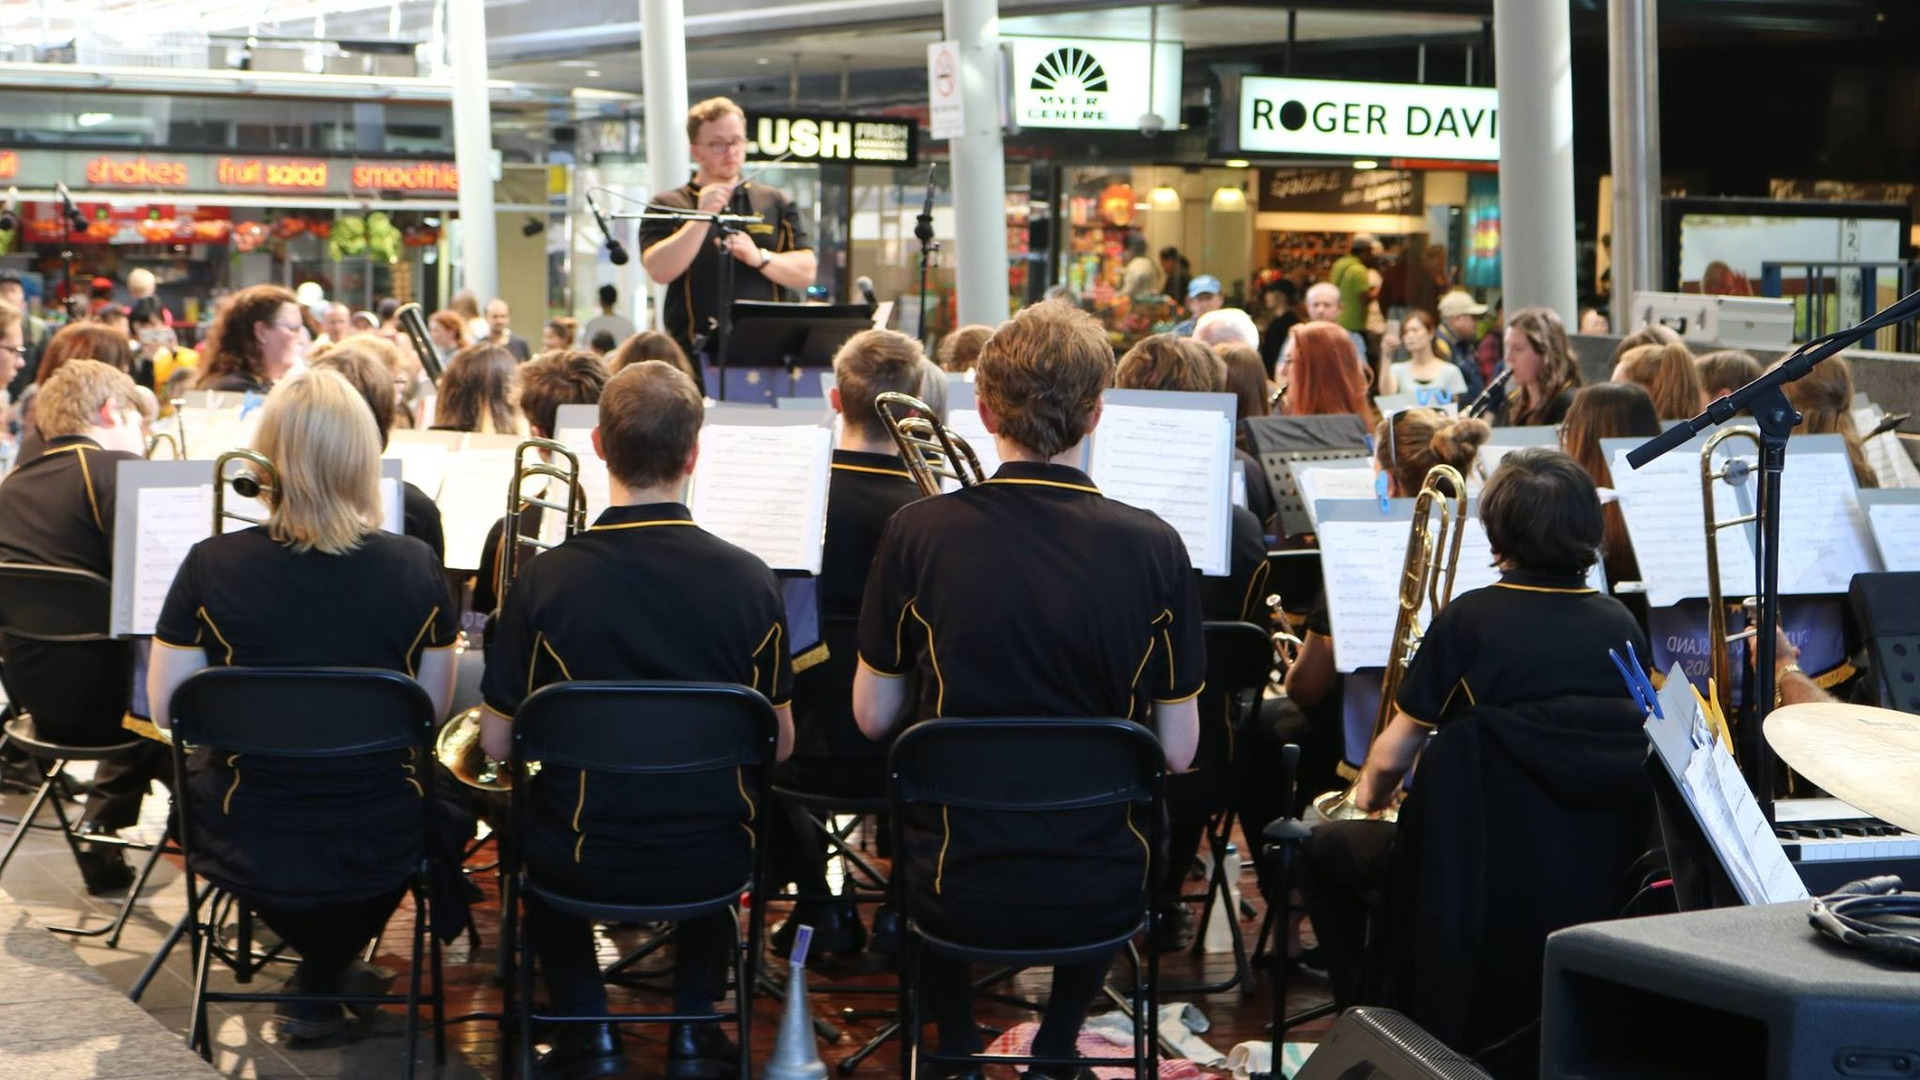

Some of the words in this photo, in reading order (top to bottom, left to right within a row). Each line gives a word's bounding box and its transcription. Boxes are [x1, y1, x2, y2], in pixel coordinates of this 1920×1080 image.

[1027, 110, 1107, 120] CENTRE
[1040, 96, 1099, 105] MYER
[1252, 98, 1387, 135] ROGER
[1406, 106, 1496, 139] DAVI
[746, 117, 852, 159] USH
[86, 155, 188, 186] shakes
[217, 157, 262, 184] fruit
[264, 161, 328, 188] salad
